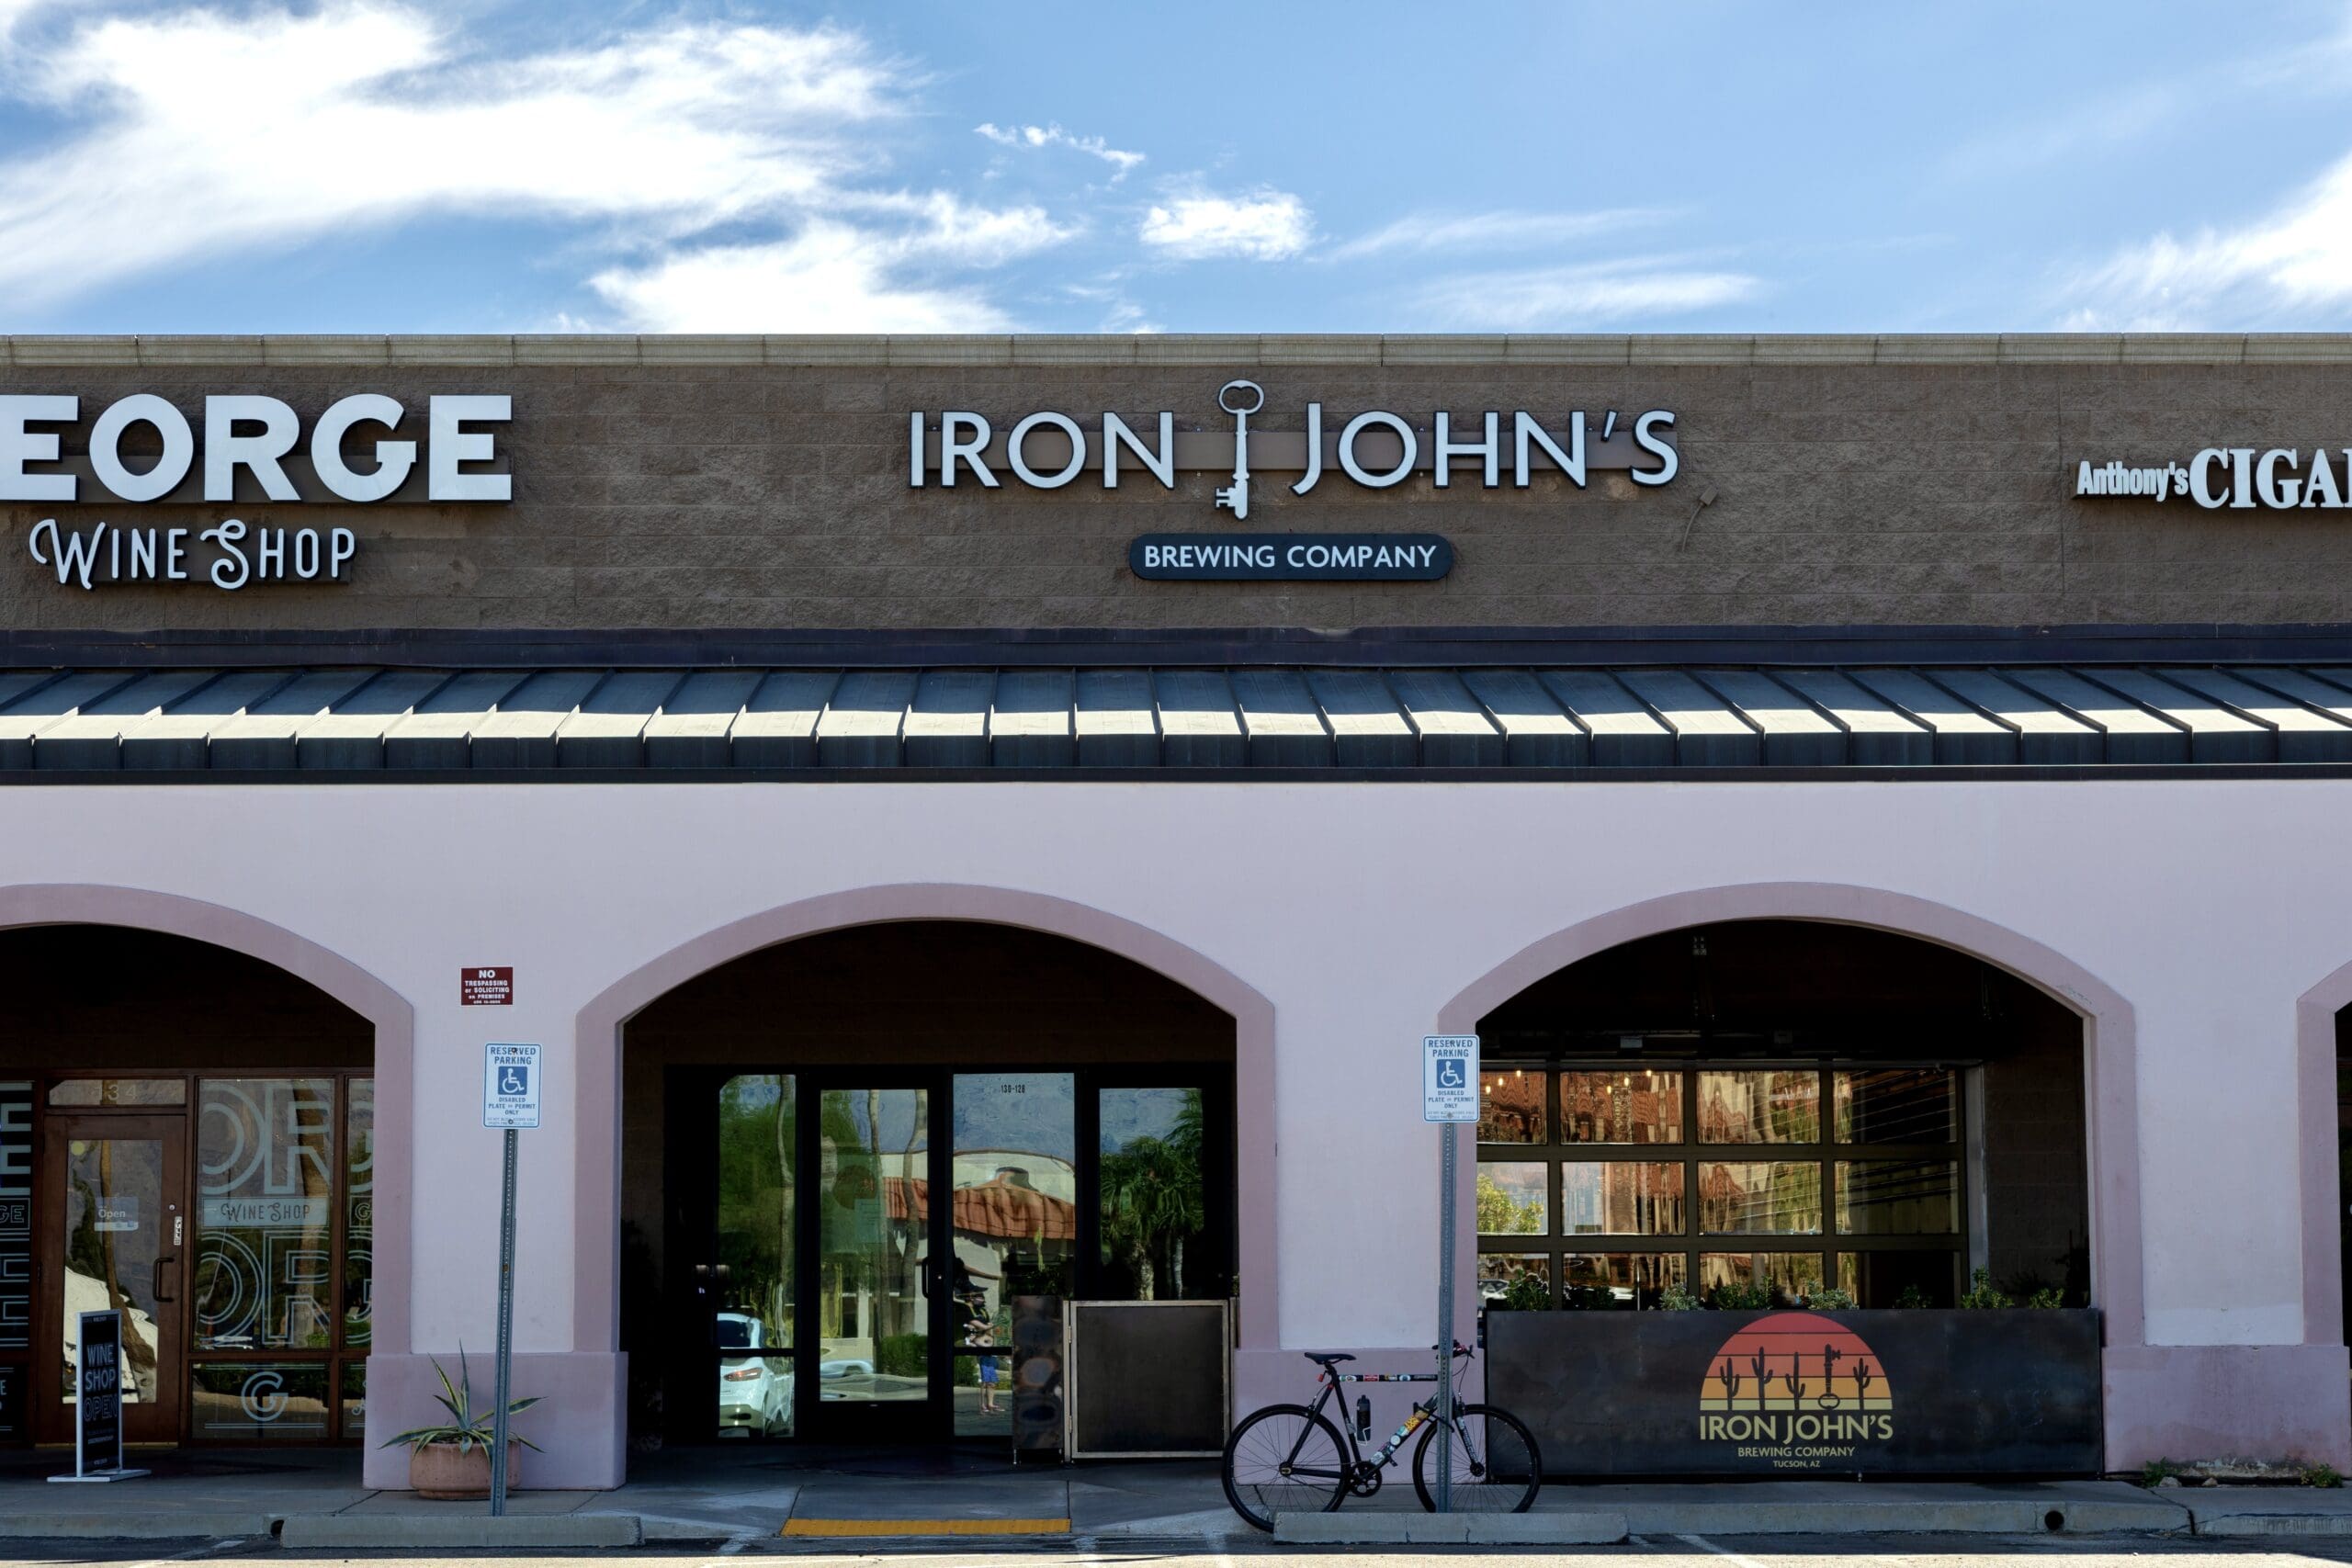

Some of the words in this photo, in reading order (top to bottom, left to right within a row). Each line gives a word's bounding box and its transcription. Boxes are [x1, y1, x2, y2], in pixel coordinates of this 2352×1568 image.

[910, 410, 1175, 490] IRON
[1290, 401, 1678, 497] JOHN'S
[2076, 460, 2188, 502] Anthony's
[2188, 447, 2352, 509] CIGA
[1144, 544, 1276, 569] BREWING
[1286, 544, 1437, 569] COMPANY
[479, 970, 495, 978] NO
[1428, 1039, 1473, 1048] RESERVED
[491, 1046, 537, 1055] RESERVED
[1432, 1049, 1469, 1057] PARKING
[494, 1055, 532, 1065] PARKING
[98, 1208, 126, 1220] Open
[86, 1344, 114, 1367] WINE
[85, 1368, 117, 1392] SHOP
[83, 1393, 118, 1422] OPEN
[1700, 1415, 1776, 1440] IRON
[1737, 1447, 1792, 1457] BREWING
[1795, 1447, 1856, 1457] COMPANY
[1773, 1461, 1808, 1469] TUCSON,
